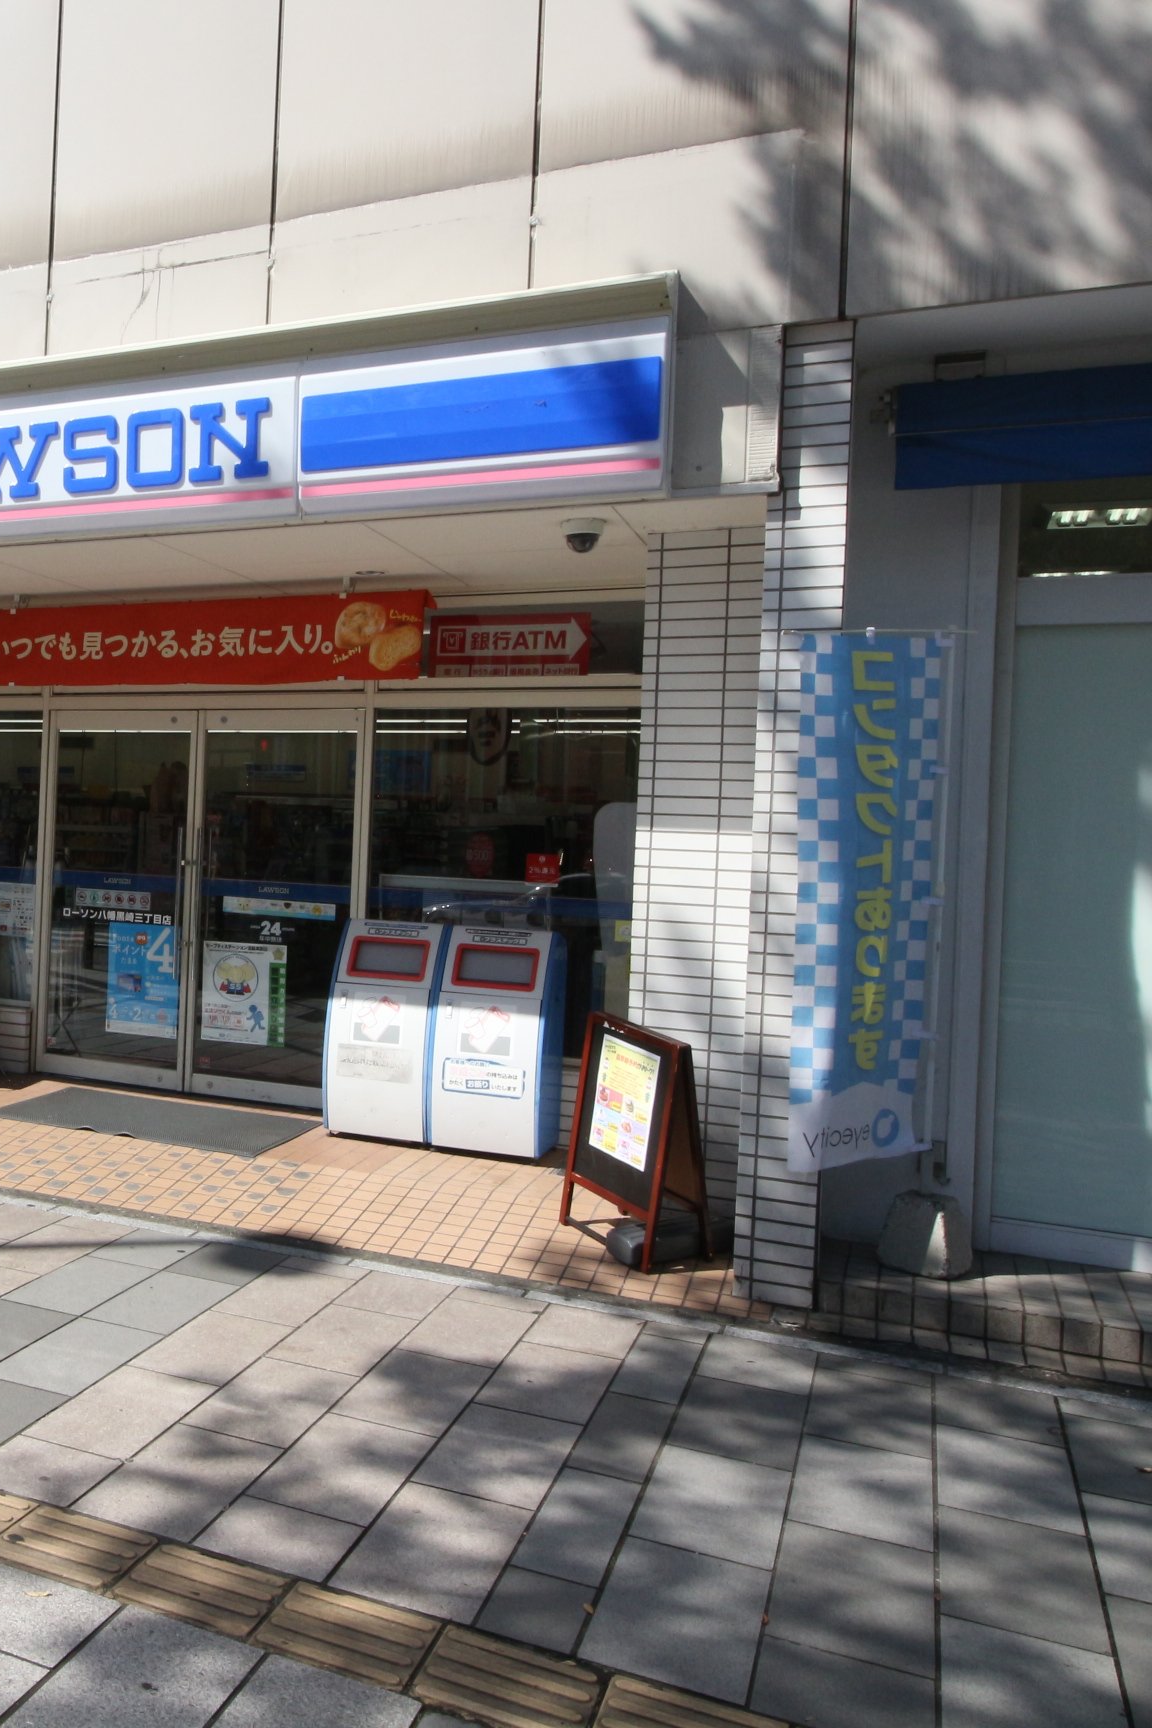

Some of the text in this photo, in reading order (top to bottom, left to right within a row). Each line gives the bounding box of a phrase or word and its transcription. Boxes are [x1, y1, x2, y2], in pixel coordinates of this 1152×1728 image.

[470, 630, 567, 651] 銀行ATM
[260, 920, 282, 937] 24
[146, 927, 176, 973] 4
